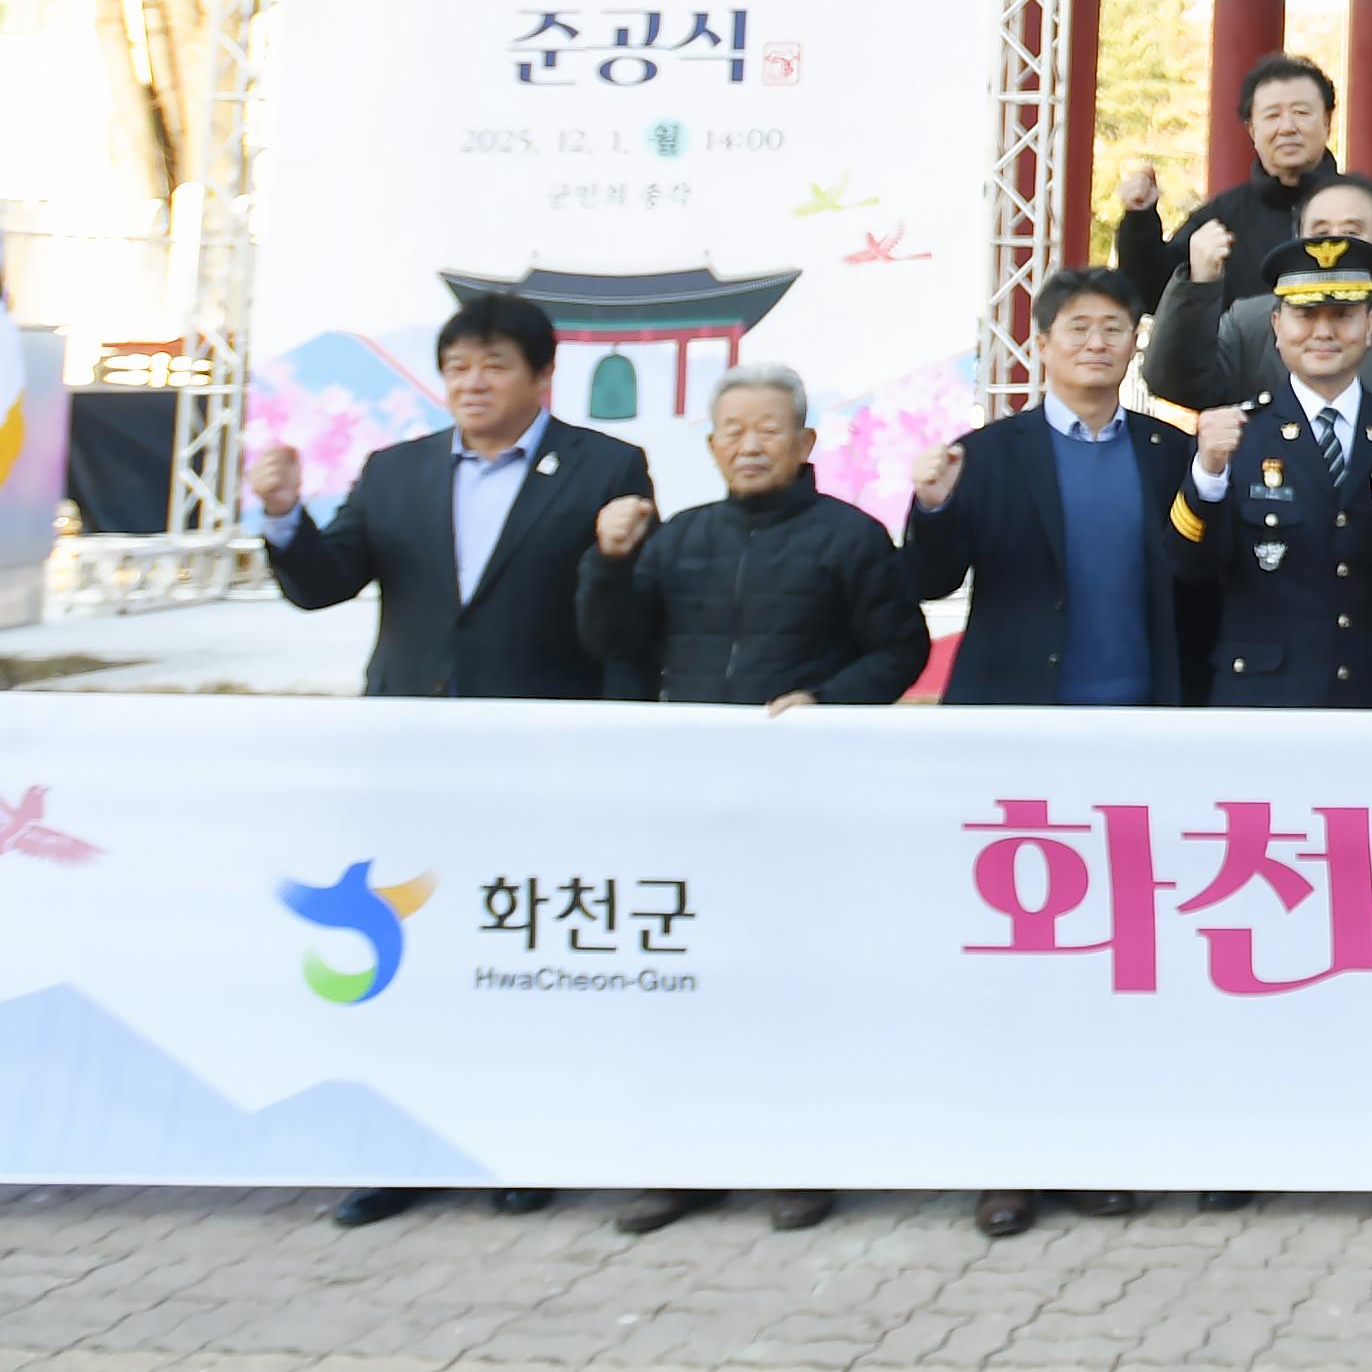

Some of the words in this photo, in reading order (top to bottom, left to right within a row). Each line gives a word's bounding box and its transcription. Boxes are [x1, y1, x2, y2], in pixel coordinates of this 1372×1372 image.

[508, 8, 748, 86] 준공식
[479, 876, 697, 954] 화천군
[474, 967, 698, 993] HwaCheon-Gun
